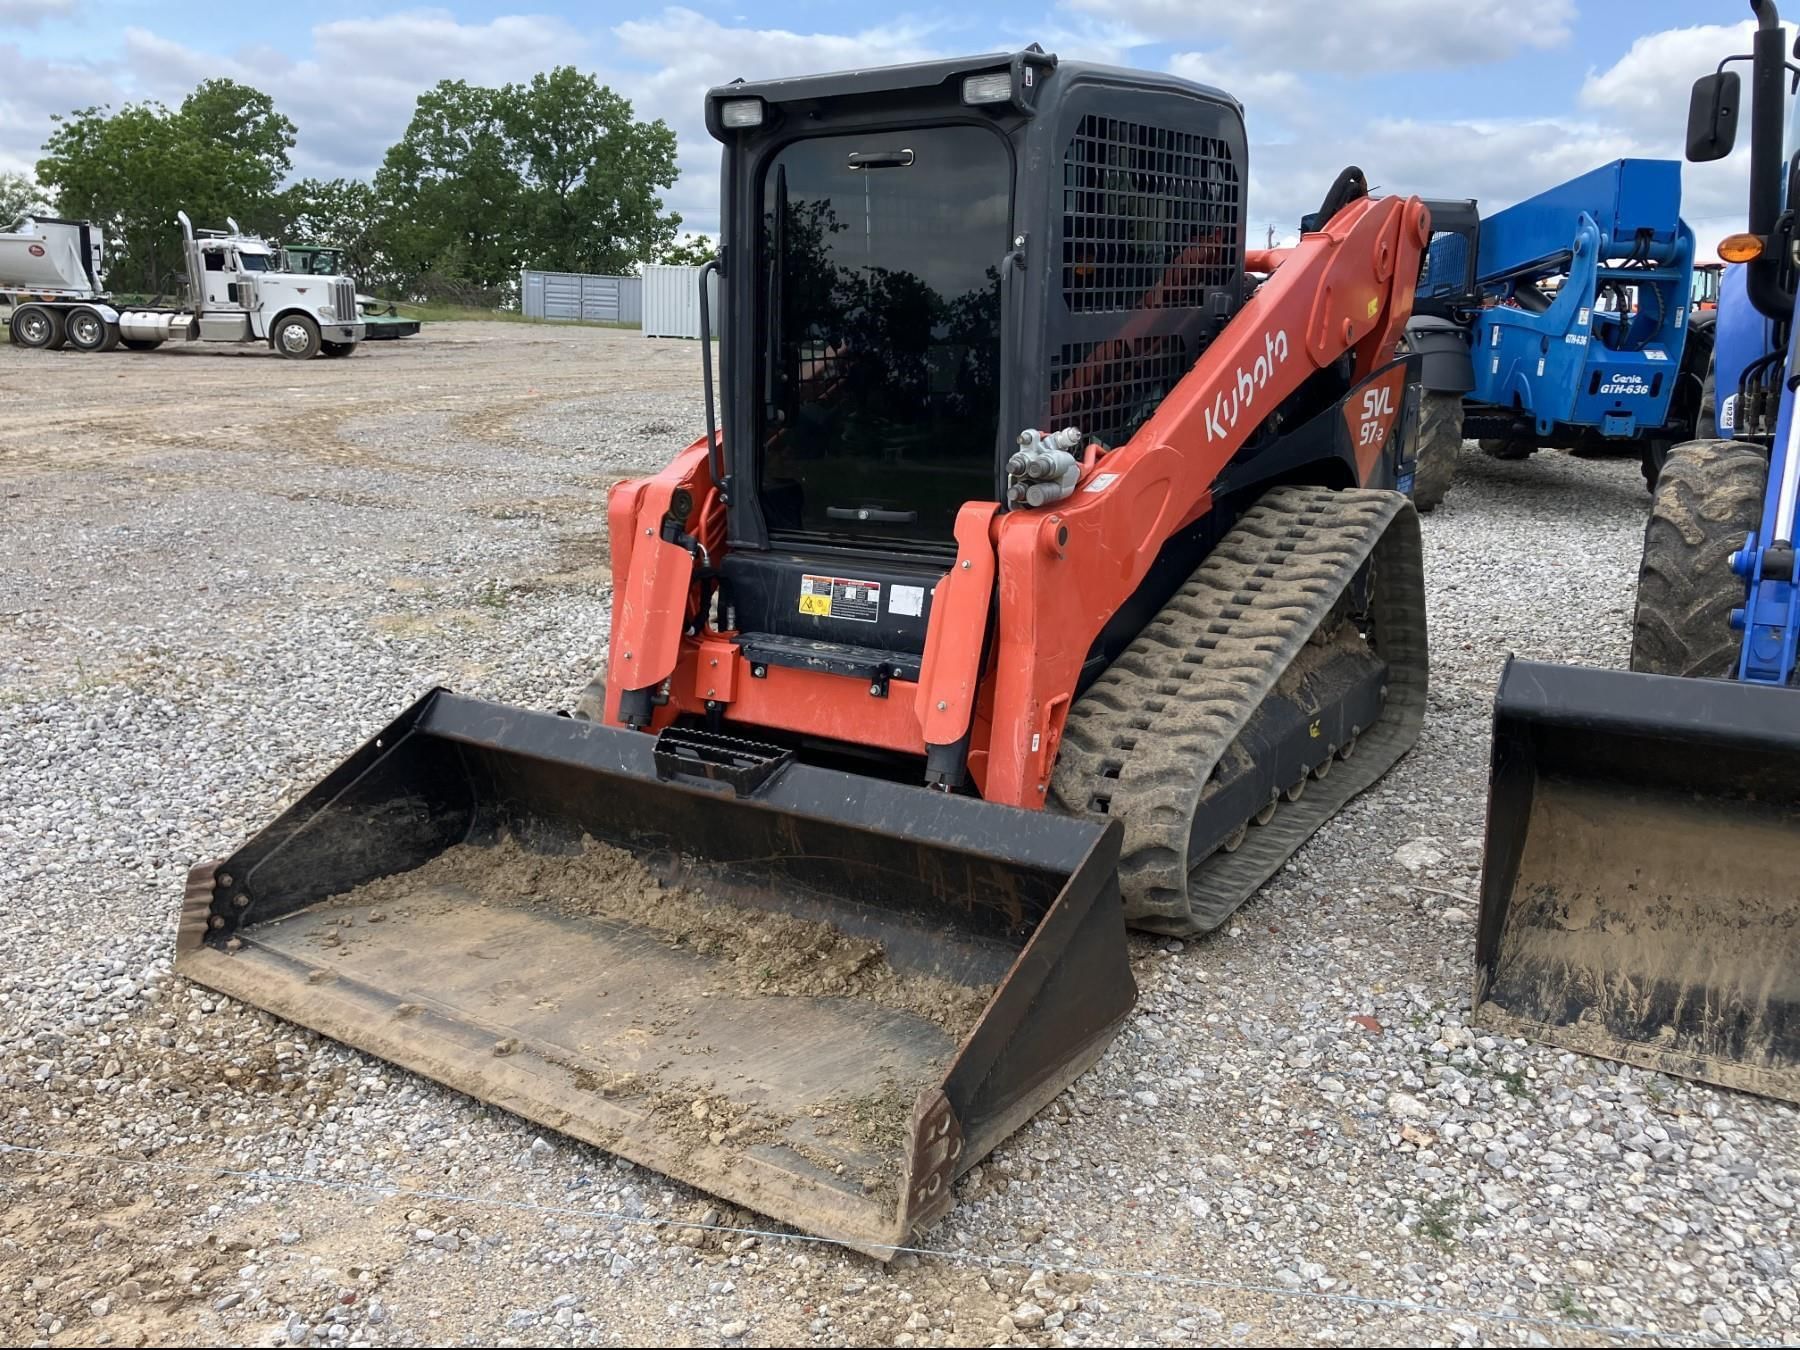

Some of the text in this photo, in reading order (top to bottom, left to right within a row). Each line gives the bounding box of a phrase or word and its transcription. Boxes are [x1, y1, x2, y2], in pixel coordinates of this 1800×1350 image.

[1565, 333, 1588, 345] GTH-636
[1204, 329, 1288, 443] Kubota
[1612, 373, 1642, 384] Genie
[1600, 384, 1649, 394] GTH-636
[1360, 386, 1394, 420] SVL
[1359, 421, 1384, 446] 97-2
